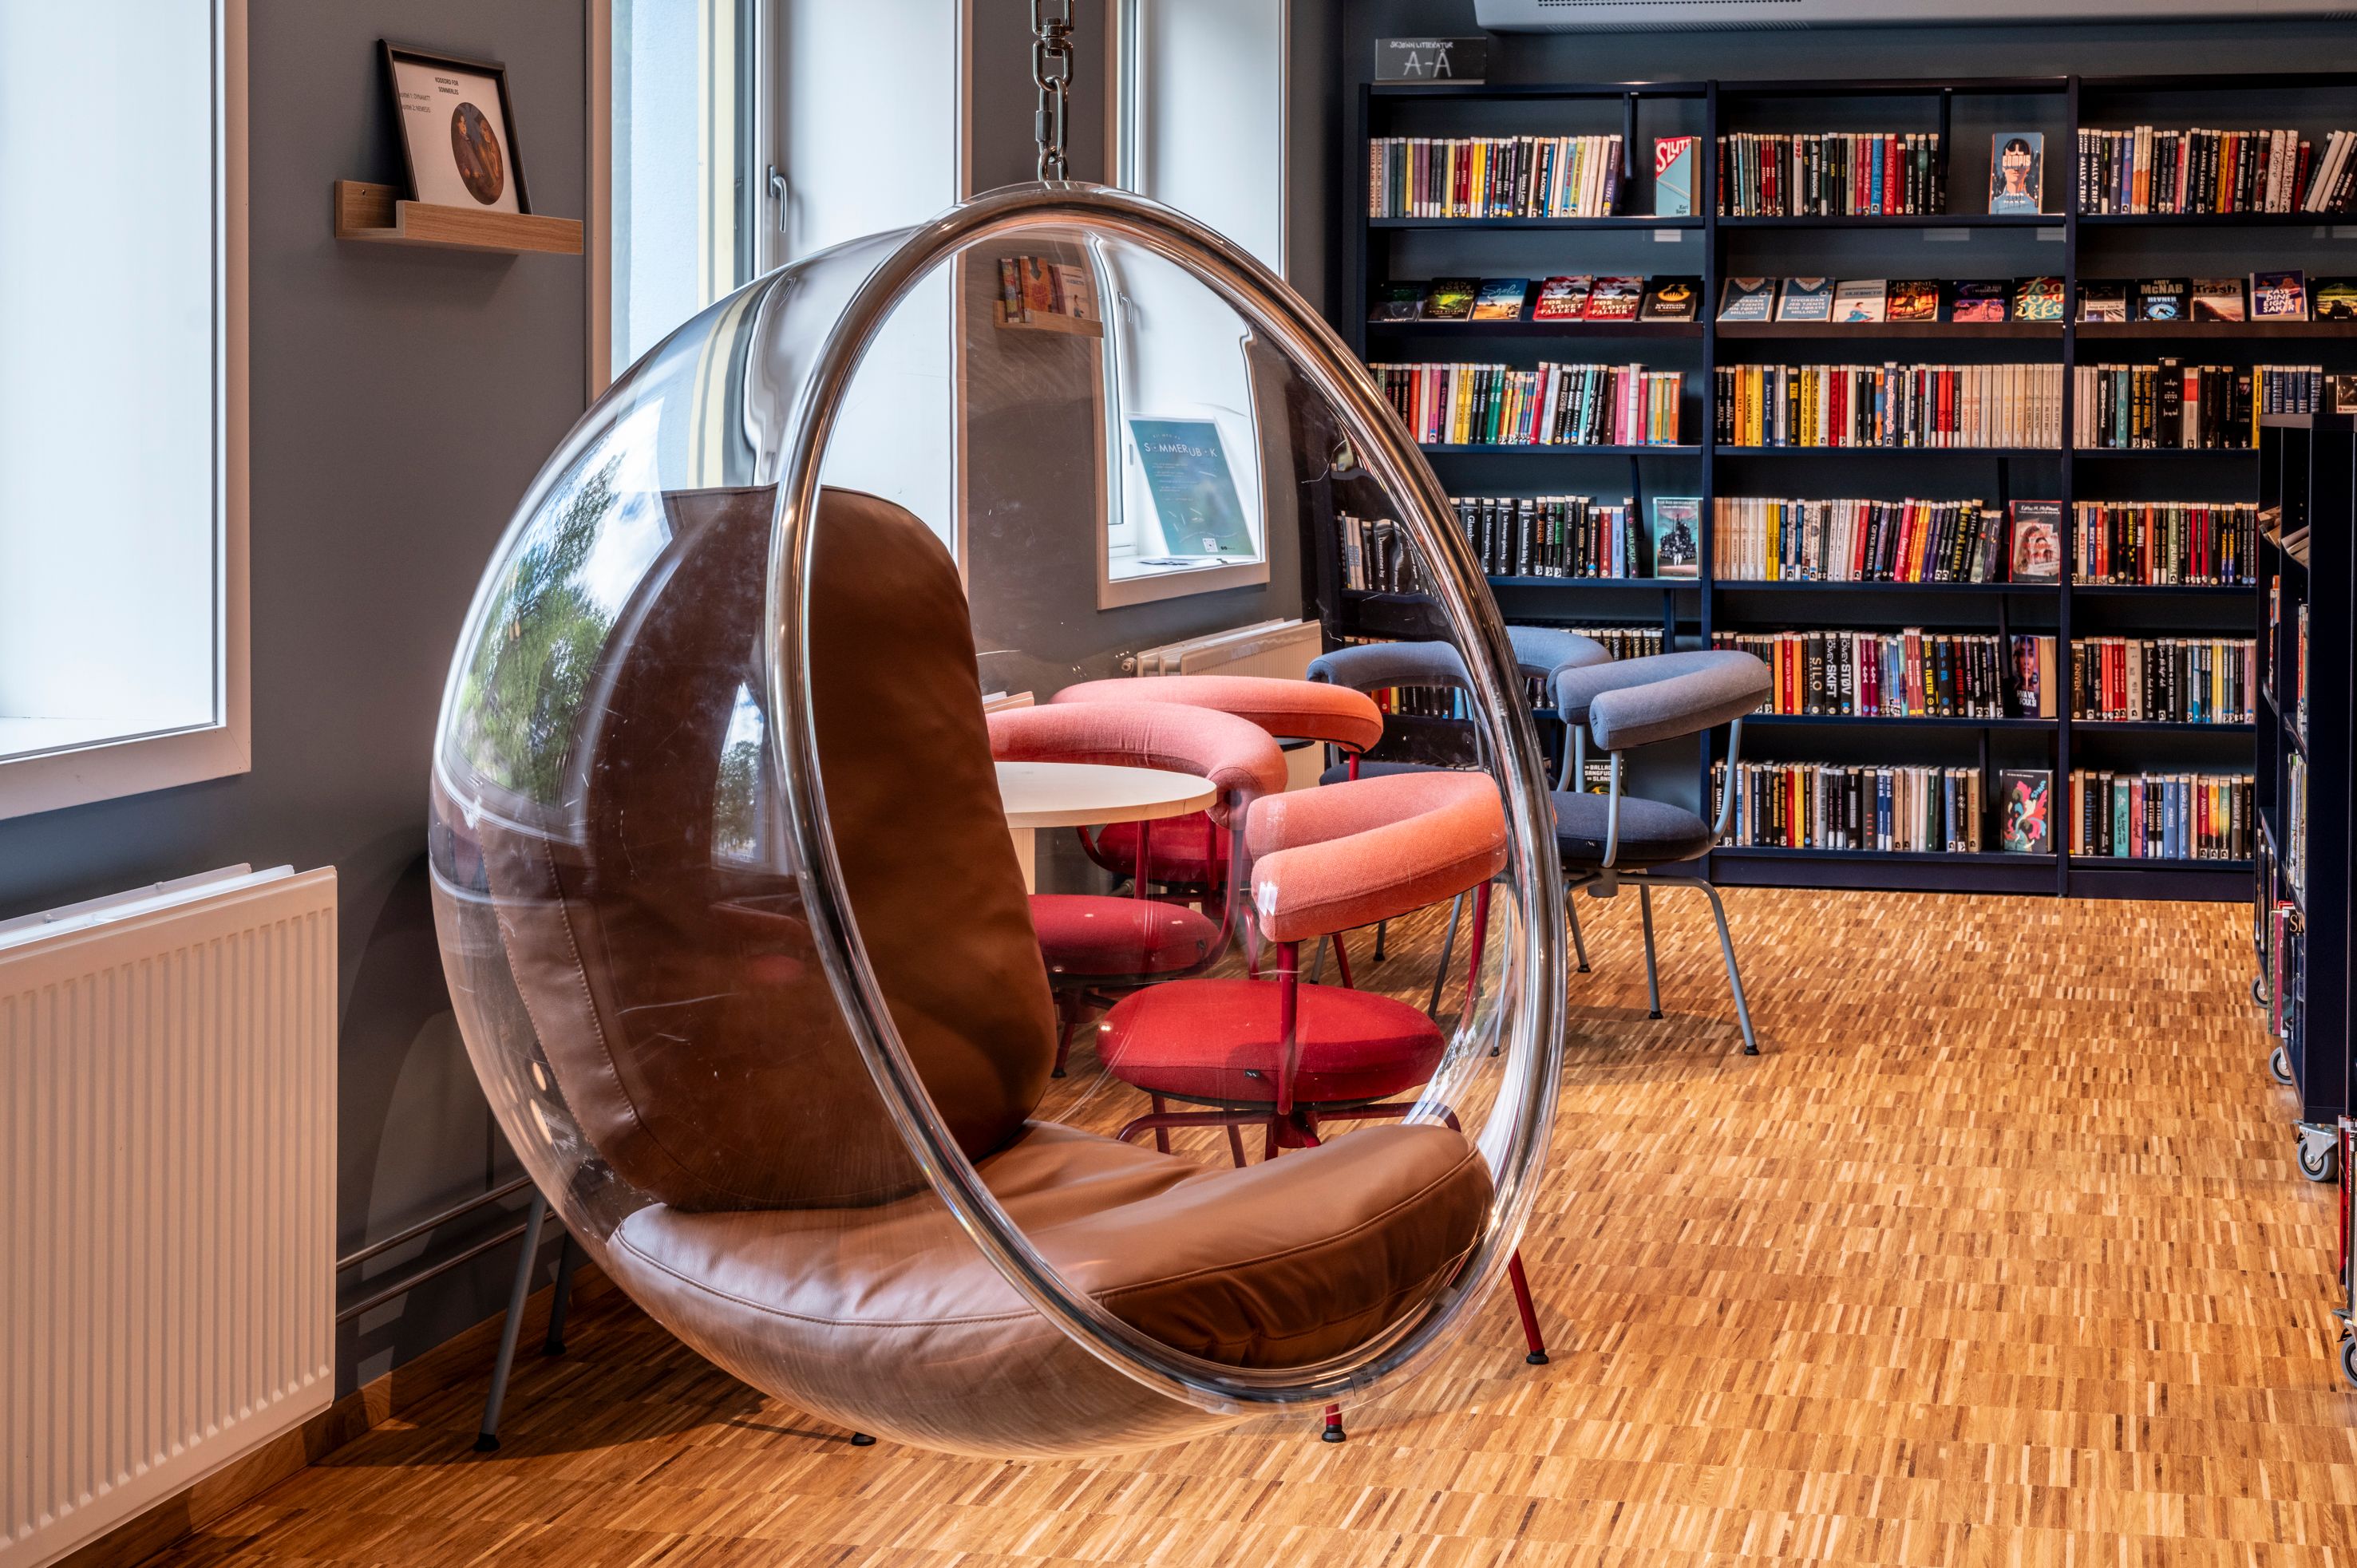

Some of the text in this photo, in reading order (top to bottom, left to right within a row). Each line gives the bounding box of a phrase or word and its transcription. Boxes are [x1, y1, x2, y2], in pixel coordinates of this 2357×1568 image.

[2272, 152, 2281, 178] Game
[1886, 177, 1892, 187] EN
[2141, 284, 2183, 294] McNAB
[1957, 534, 1966, 543] PÅ
[1953, 547, 1962, 570] LEKEN
[1812, 658, 1821, 691] SILO
[1826, 664, 1837, 697] SKIFT
[1841, 664, 1851, 694] STØV
[2086, 791, 2096, 842] delirium
